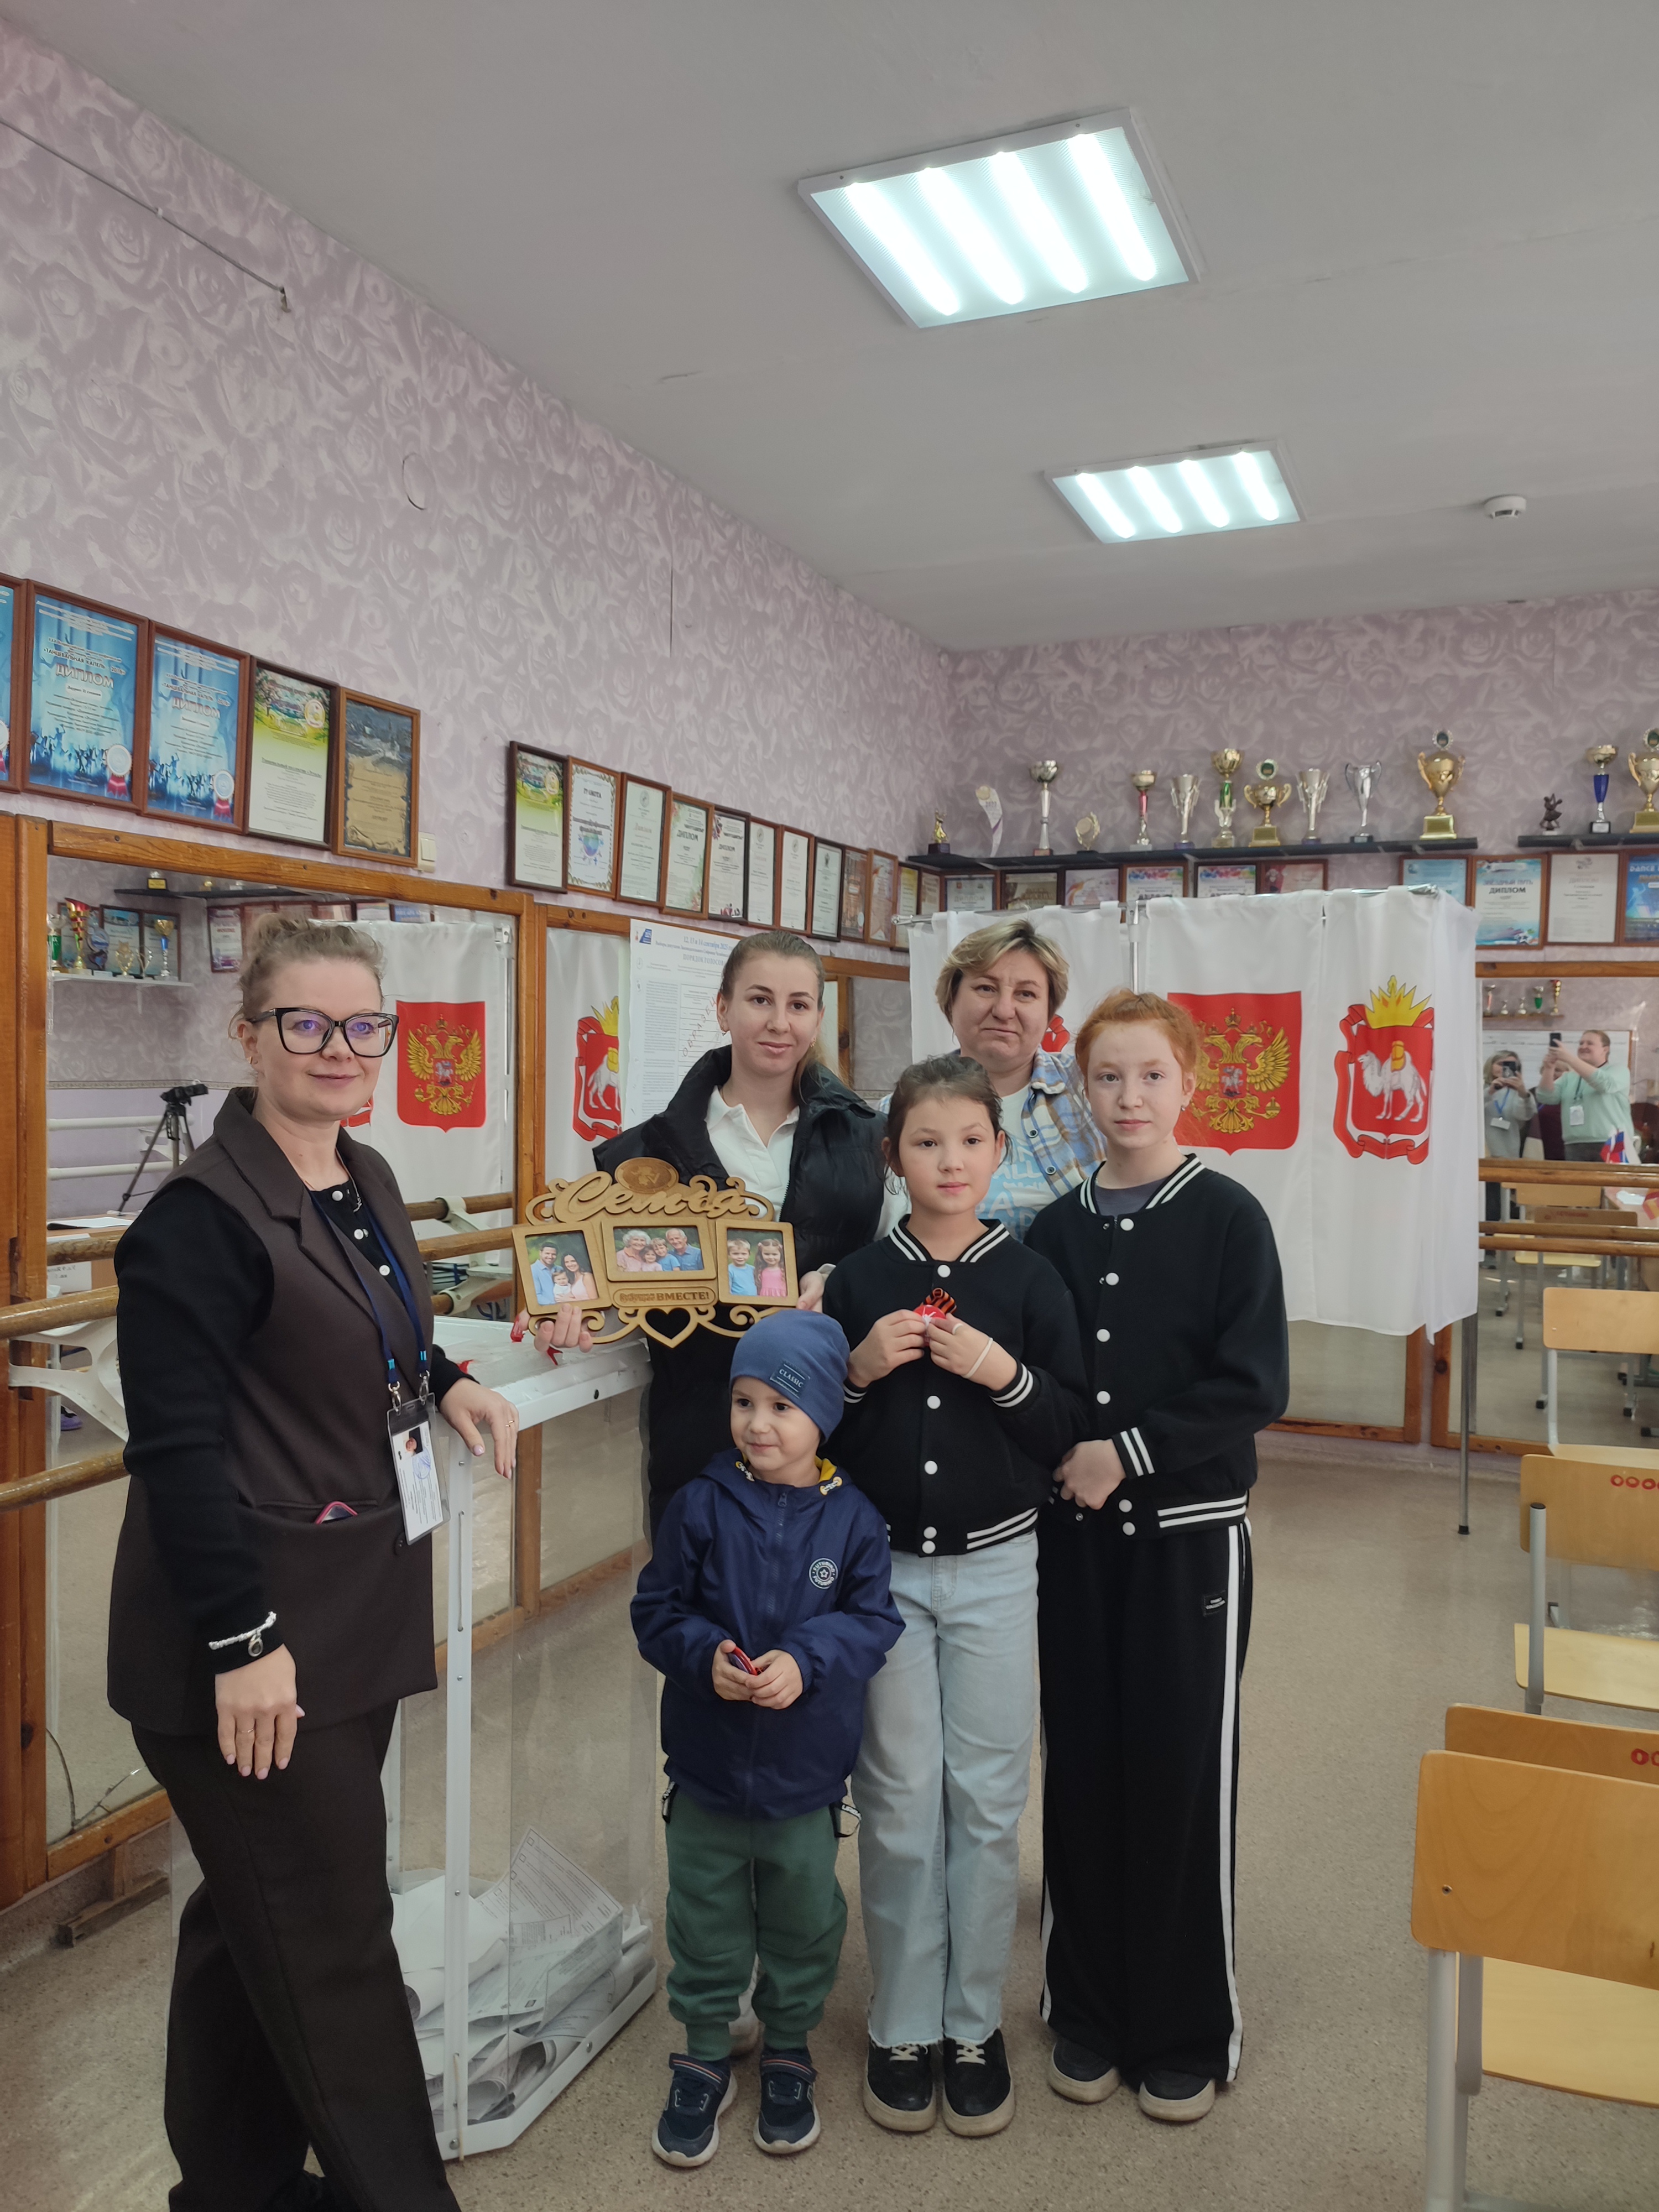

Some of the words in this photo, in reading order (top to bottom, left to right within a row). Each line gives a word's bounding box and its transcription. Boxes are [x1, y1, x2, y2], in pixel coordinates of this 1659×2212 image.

[56, 663, 114, 689] ДИПЛОМ
[172, 697, 221, 719] ДИПЛОМ
[677, 830, 698, 841] ДИПЛОМ
[683, 954, 703, 963] ПОРЯДОК
[704, 957, 726, 966] ГОЛОСОВ
[554, 1171, 749, 1223] Семья
[656, 1291, 709, 1301] ВМЕСТЕ!
[779, 1369, 804, 1387] CLASSIC
